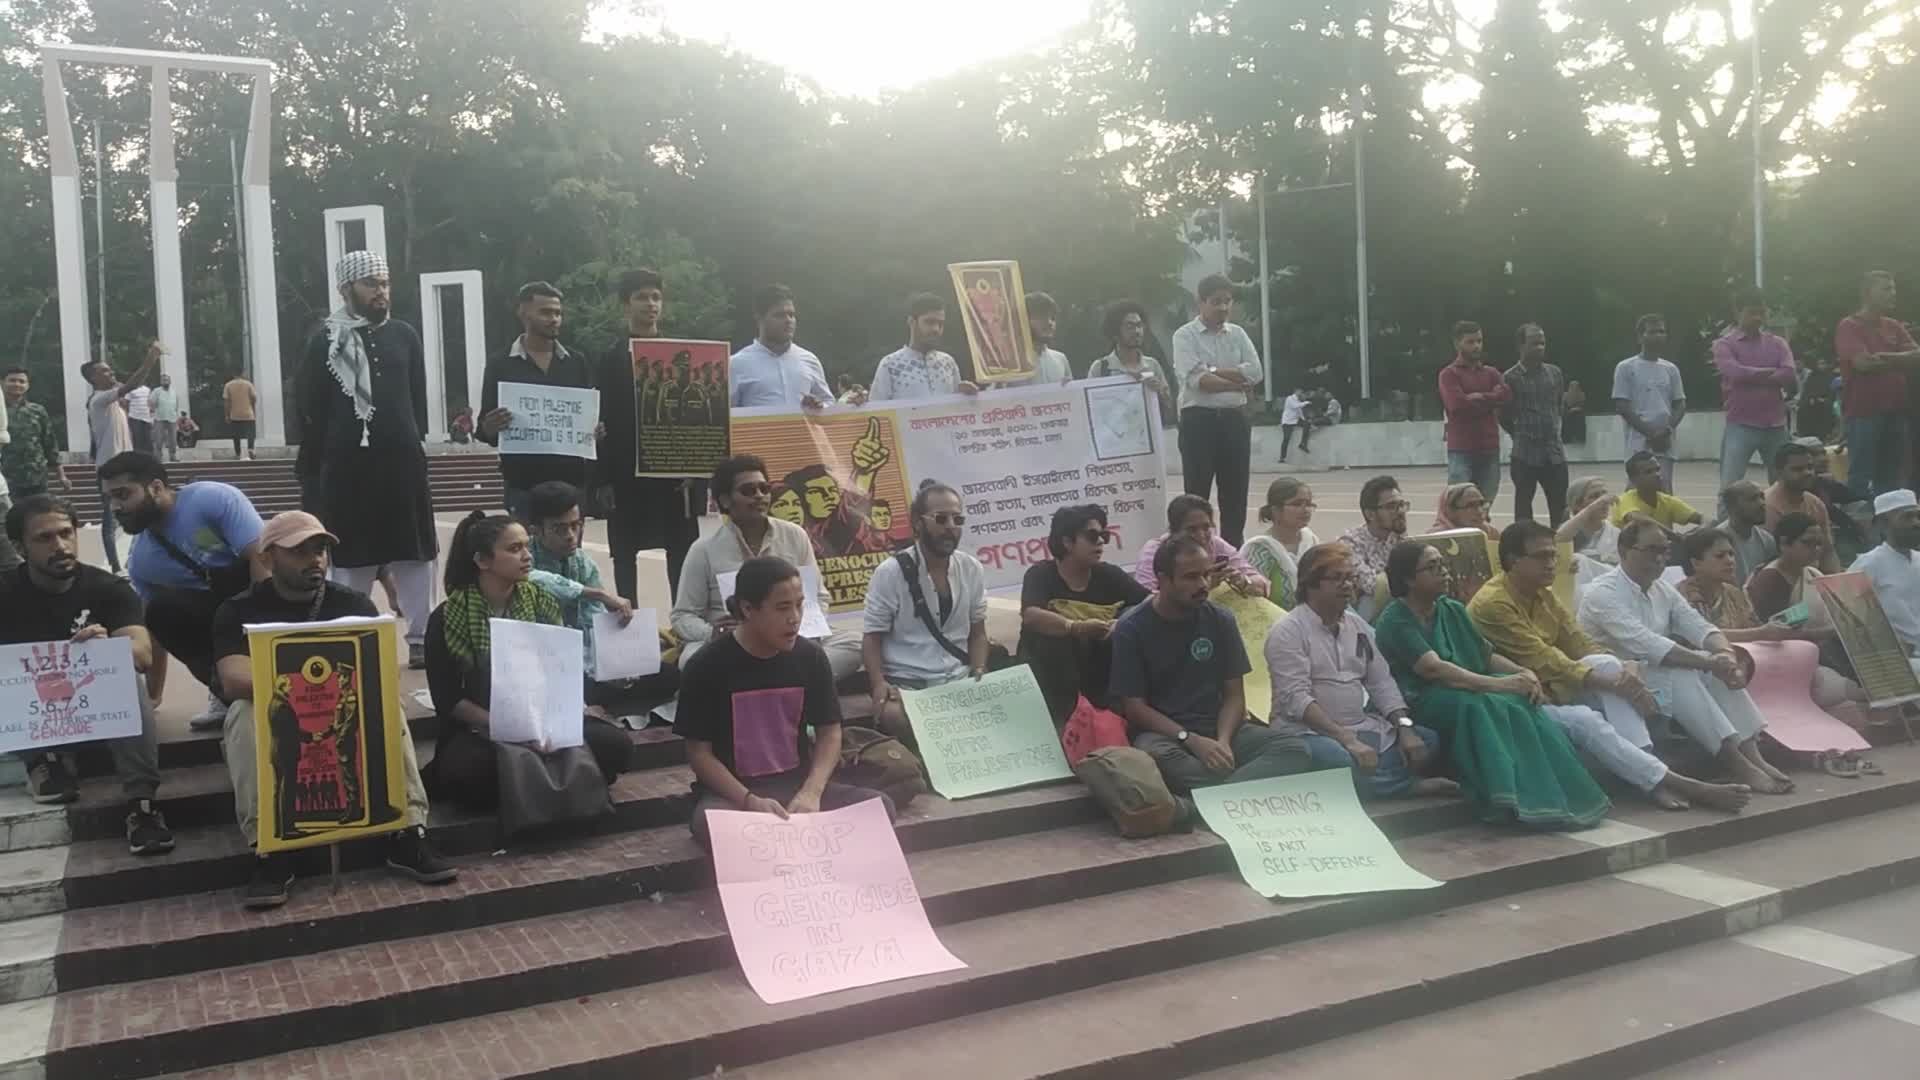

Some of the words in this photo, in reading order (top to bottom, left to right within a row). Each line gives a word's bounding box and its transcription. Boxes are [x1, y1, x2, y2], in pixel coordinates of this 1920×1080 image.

[1223, 791, 1324, 819] BOMBING
[742, 821, 856, 862] STOP
[1256, 840, 1272, 853] IS
[1278, 839, 1306, 852] NOT
[773, 860, 838, 889] THE
[753, 878, 918, 927] GENOCIDE
[804, 922, 843, 945] IN
